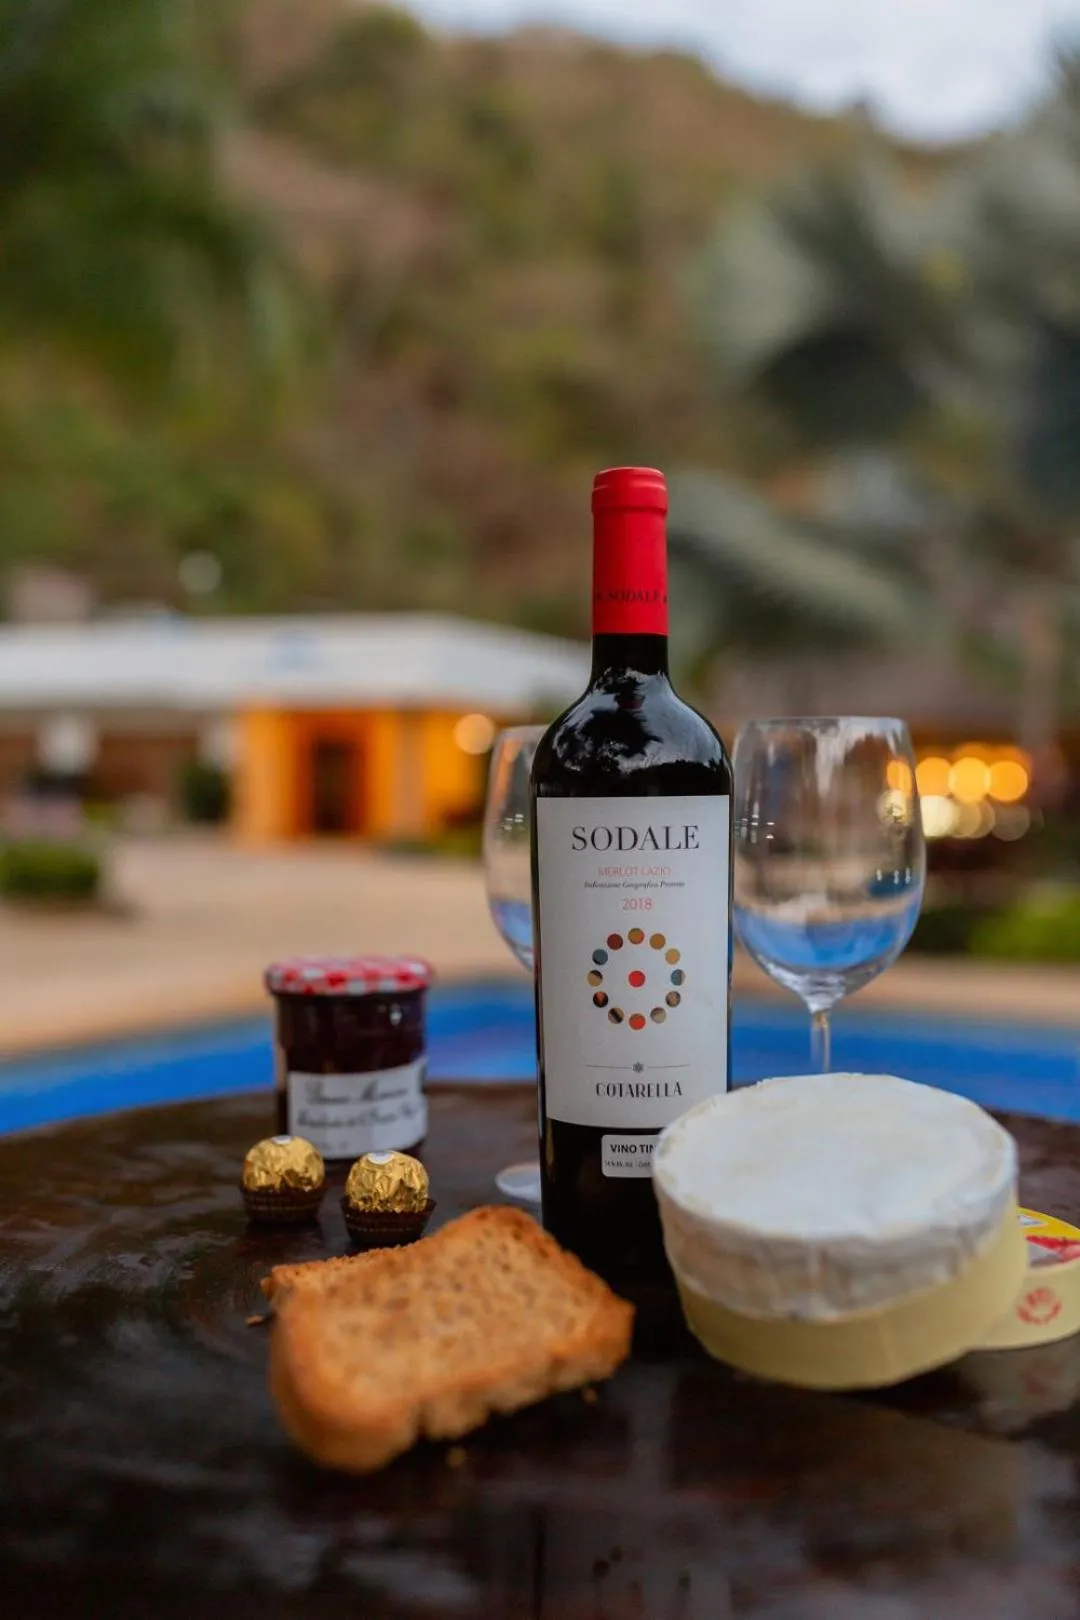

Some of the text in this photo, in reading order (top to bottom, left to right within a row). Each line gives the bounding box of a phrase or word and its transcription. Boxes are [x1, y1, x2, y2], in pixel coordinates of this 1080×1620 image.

[572, 825, 700, 851] SODALE
[598, 866, 671, 877] MERLOT LAZIO
[622, 897, 653, 911] 2018
[596, 1081, 683, 1098] COTARELLA
[610, 1144, 637, 1154] VINO
